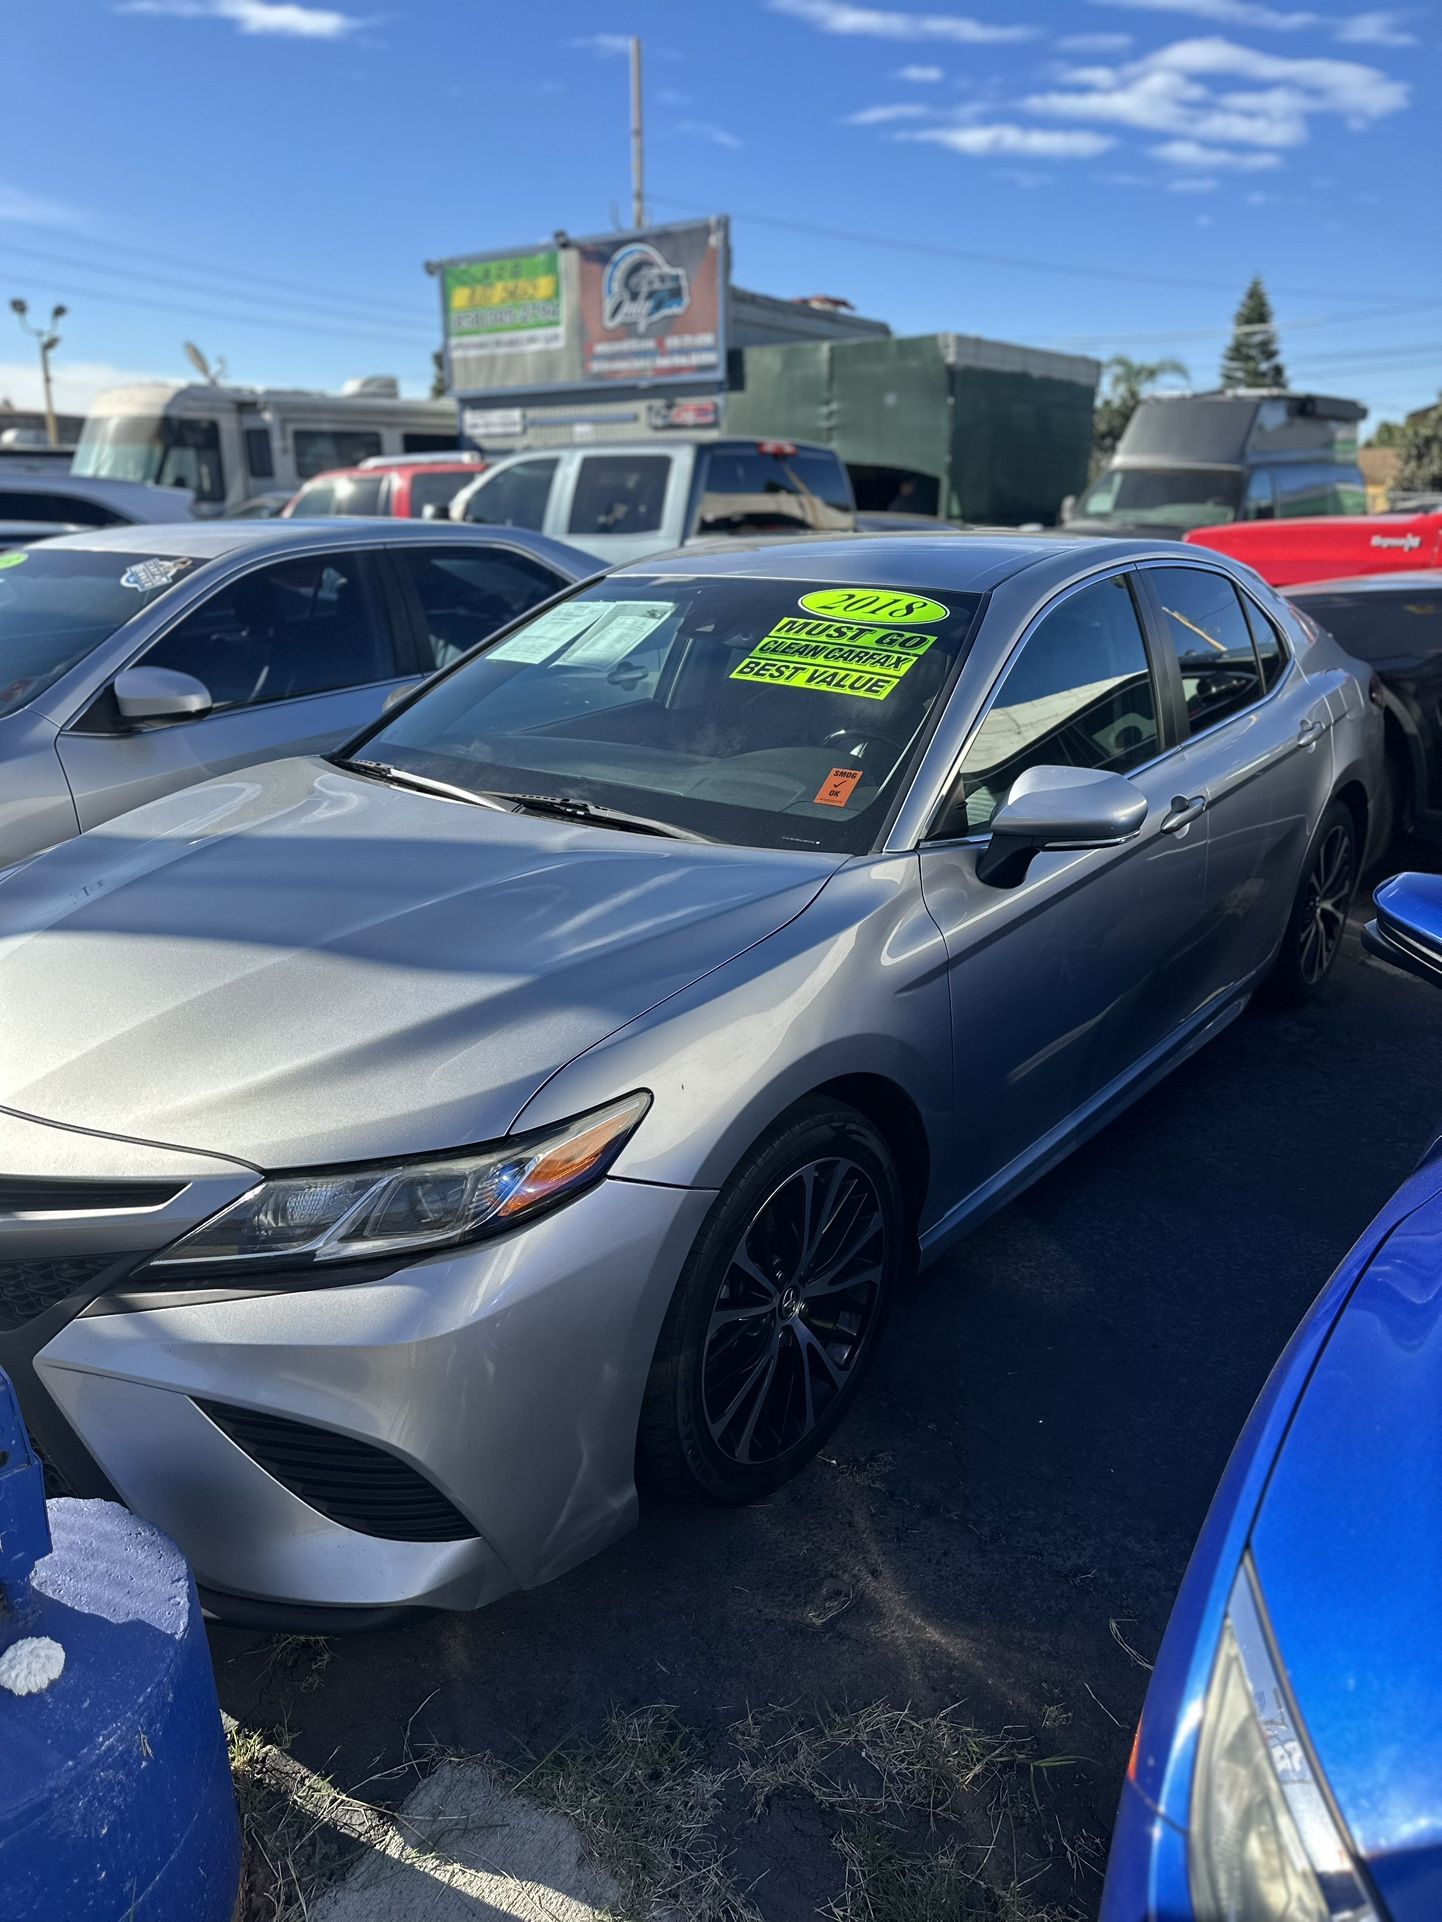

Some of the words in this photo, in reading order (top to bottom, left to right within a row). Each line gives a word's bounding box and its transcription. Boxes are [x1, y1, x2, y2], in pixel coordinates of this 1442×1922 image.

[815, 593, 928, 618] 2018
[776, 619, 875, 642] MUST
[875, 632, 930, 651] GO
[758, 639, 828, 659] CLEAN
[823, 647, 913, 671] CARFAX
[737, 660, 807, 680] BEST
[804, 669, 891, 693] VALUE
[833, 770, 858, 779] SMOG
[828, 789, 840, 797] OK
